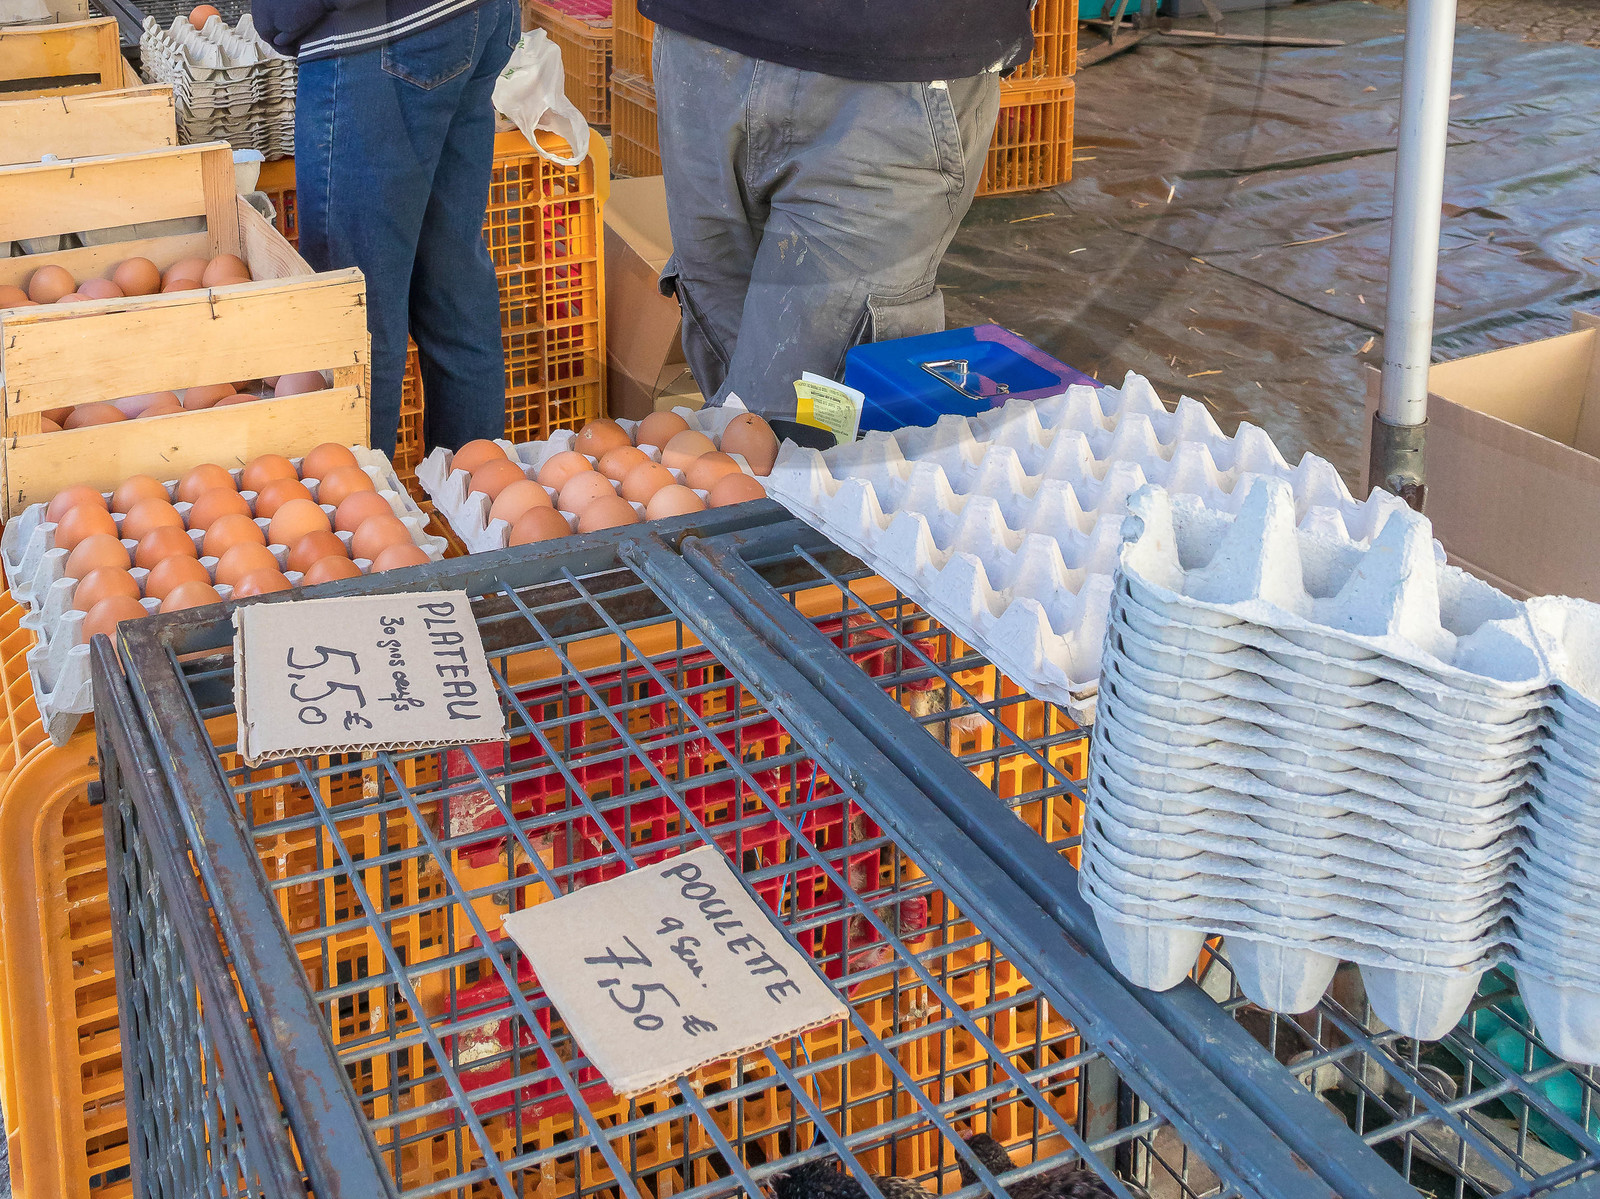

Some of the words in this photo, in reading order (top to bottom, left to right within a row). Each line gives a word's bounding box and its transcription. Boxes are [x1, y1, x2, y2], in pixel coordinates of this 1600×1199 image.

[379, 615, 405, 635] 30
[417, 601, 482, 720] PLATEAU
[660, 862, 802, 1004] POULETTE
